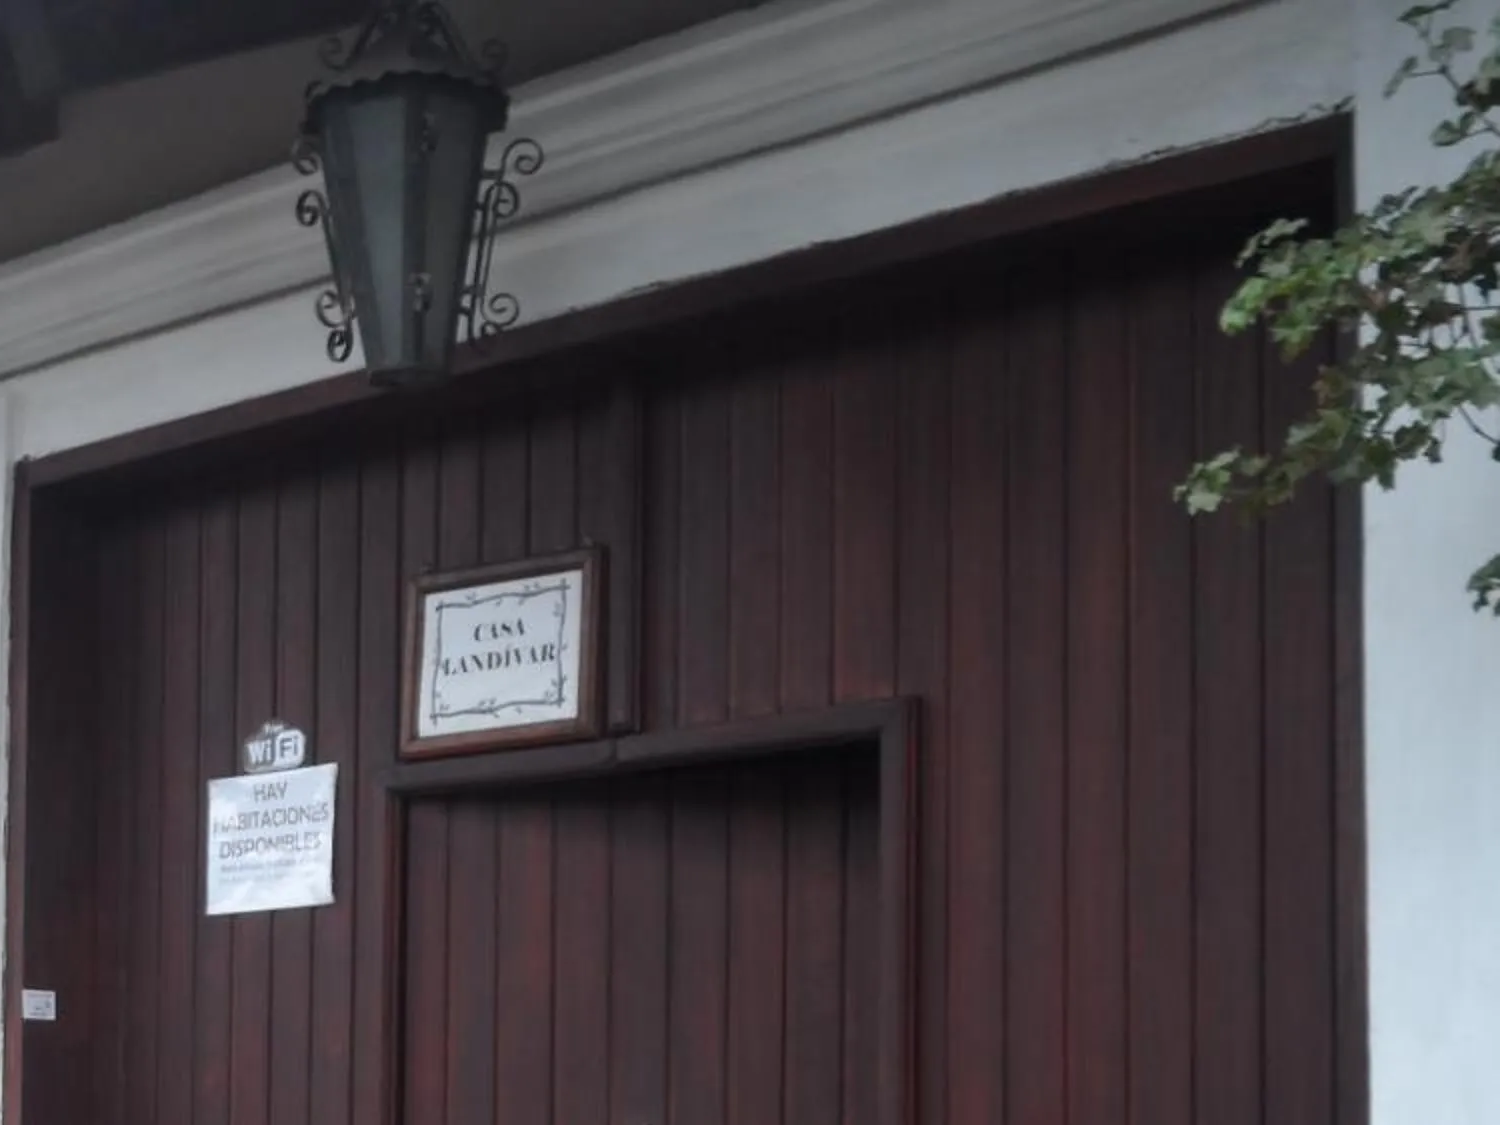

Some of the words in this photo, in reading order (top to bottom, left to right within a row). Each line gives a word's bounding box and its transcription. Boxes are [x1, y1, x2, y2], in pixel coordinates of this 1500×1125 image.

[473, 617, 525, 642] CASA
[253, 782, 287, 803] HAY
[213, 802, 328, 834] HABITACIONES
[219, 831, 322, 860] DISPONIBLES
